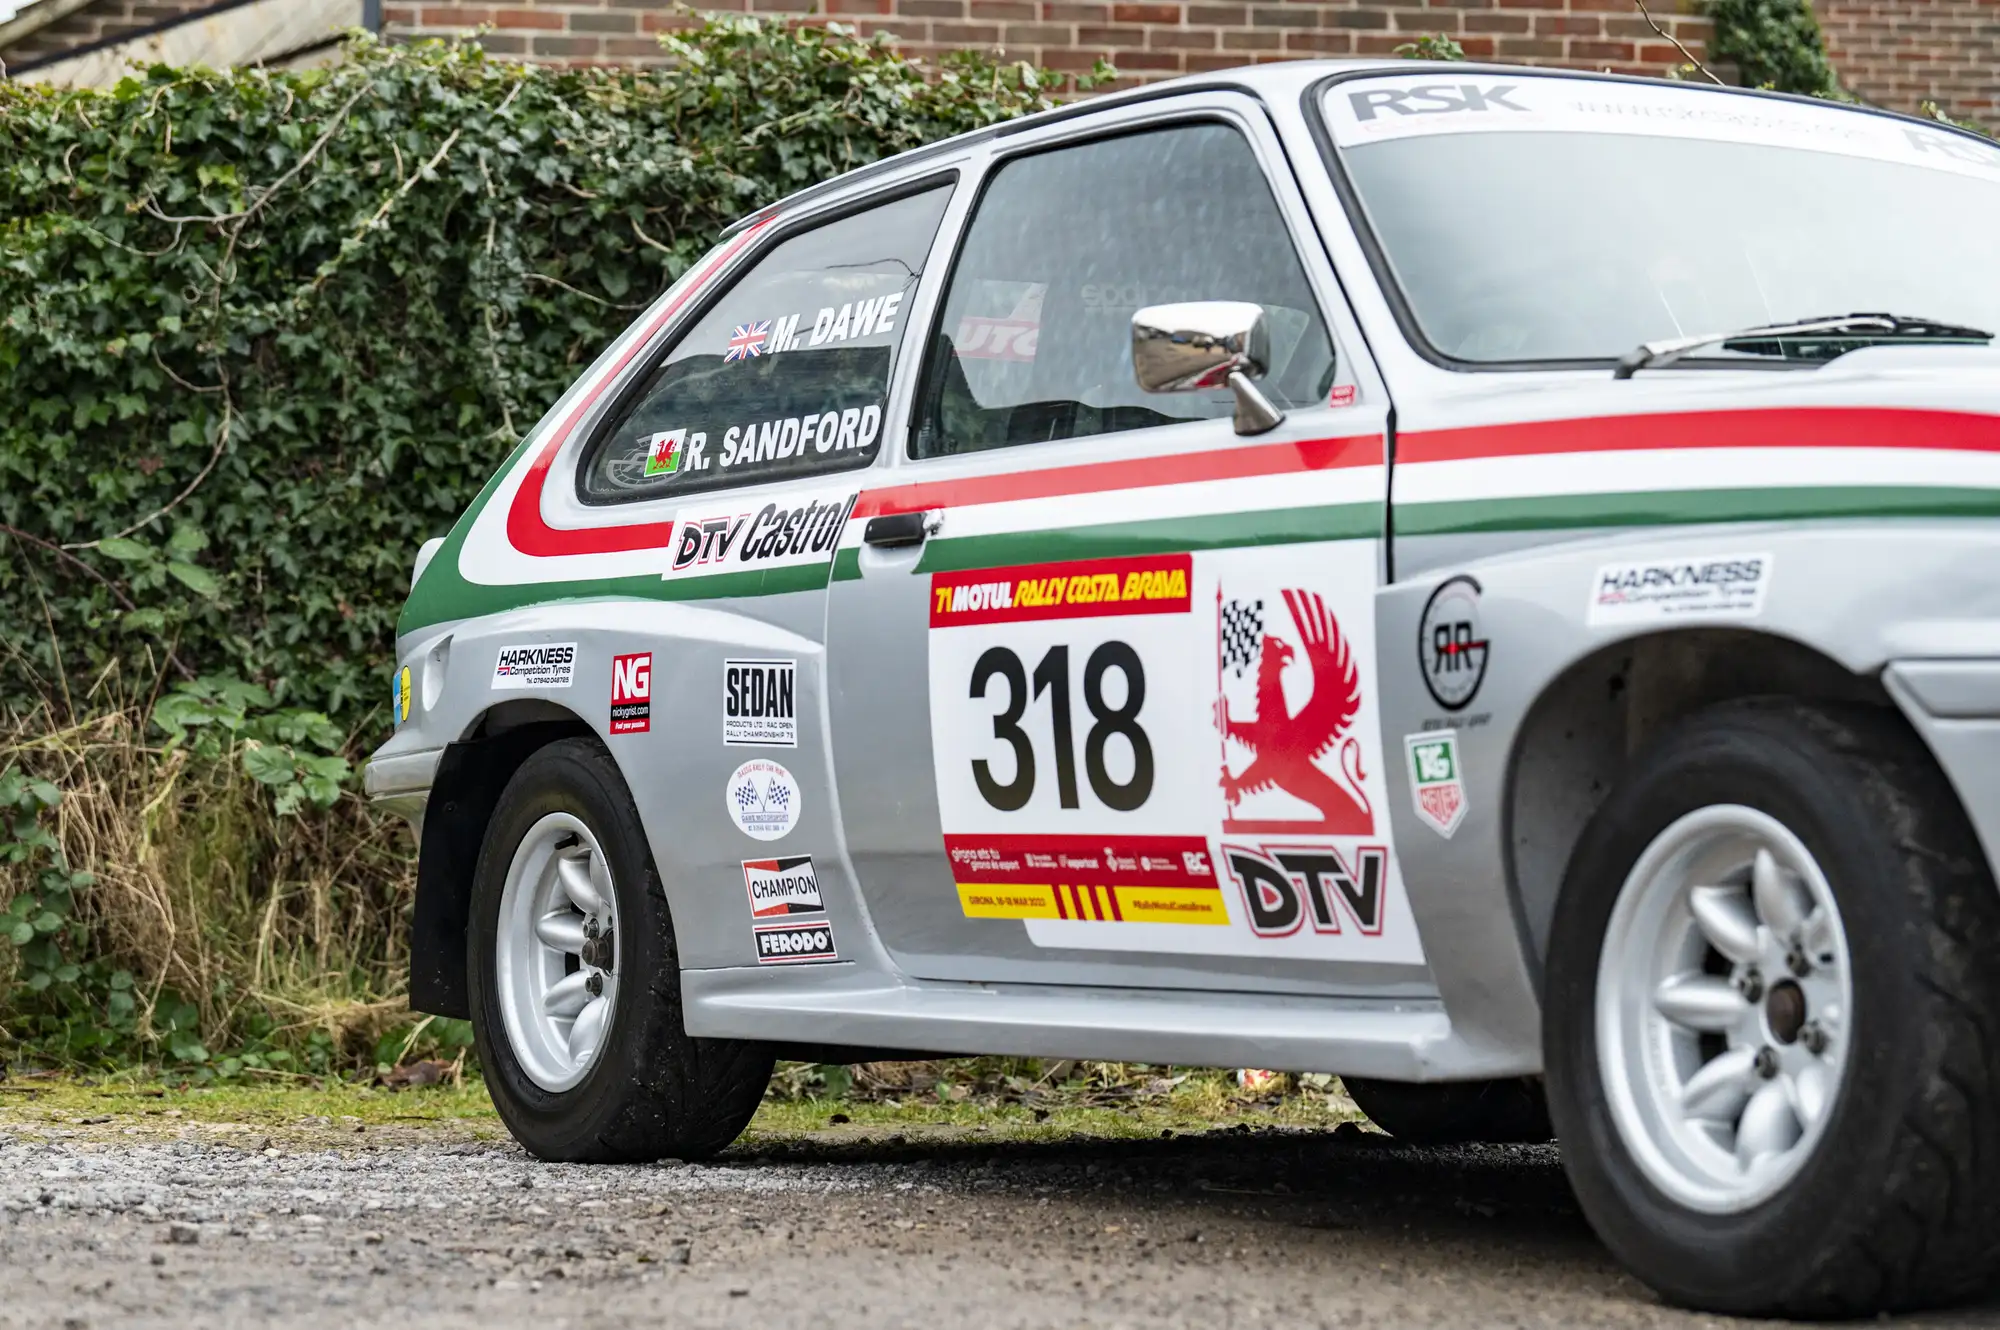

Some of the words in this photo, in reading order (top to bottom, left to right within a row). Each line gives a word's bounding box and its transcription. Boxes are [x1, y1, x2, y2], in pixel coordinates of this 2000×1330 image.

[1347, 85, 1532, 122] RSK
[767, 314, 801, 354] M.
[809, 292, 903, 346] DAWE
[684, 432, 710, 471] R.
[720, 405, 881, 467] SANDFORD
[673, 513, 751, 570] DTV
[740, 495, 853, 561] Castrol
[935, 587, 952, 613] 71
[952, 582, 1013, 612] MOTUL
[1013, 576, 1068, 608] RALLY
[1066, 573, 1119, 604] COSTA
[1121, 569, 1187, 600] BRAVA
[1602, 560, 1761, 590] HARKNESS
[499, 647, 573, 666] HARKNESS
[510, 666, 550, 677] Competition
[552, 665, 571, 676] Tyres
[613, 656, 650, 700] NG
[727, 668, 793, 718] SEDAN
[613, 706, 648, 719] nickygrist.com
[726, 720, 752, 728] PRODUCTS
[970, 640, 1155, 811] 318
[743, 730, 784, 738] CHAMPIONSHIP
[752, 875, 817, 899] CHAMPION
[1221, 843, 1388, 937] DTV
[760, 931, 828, 954] FERODO
